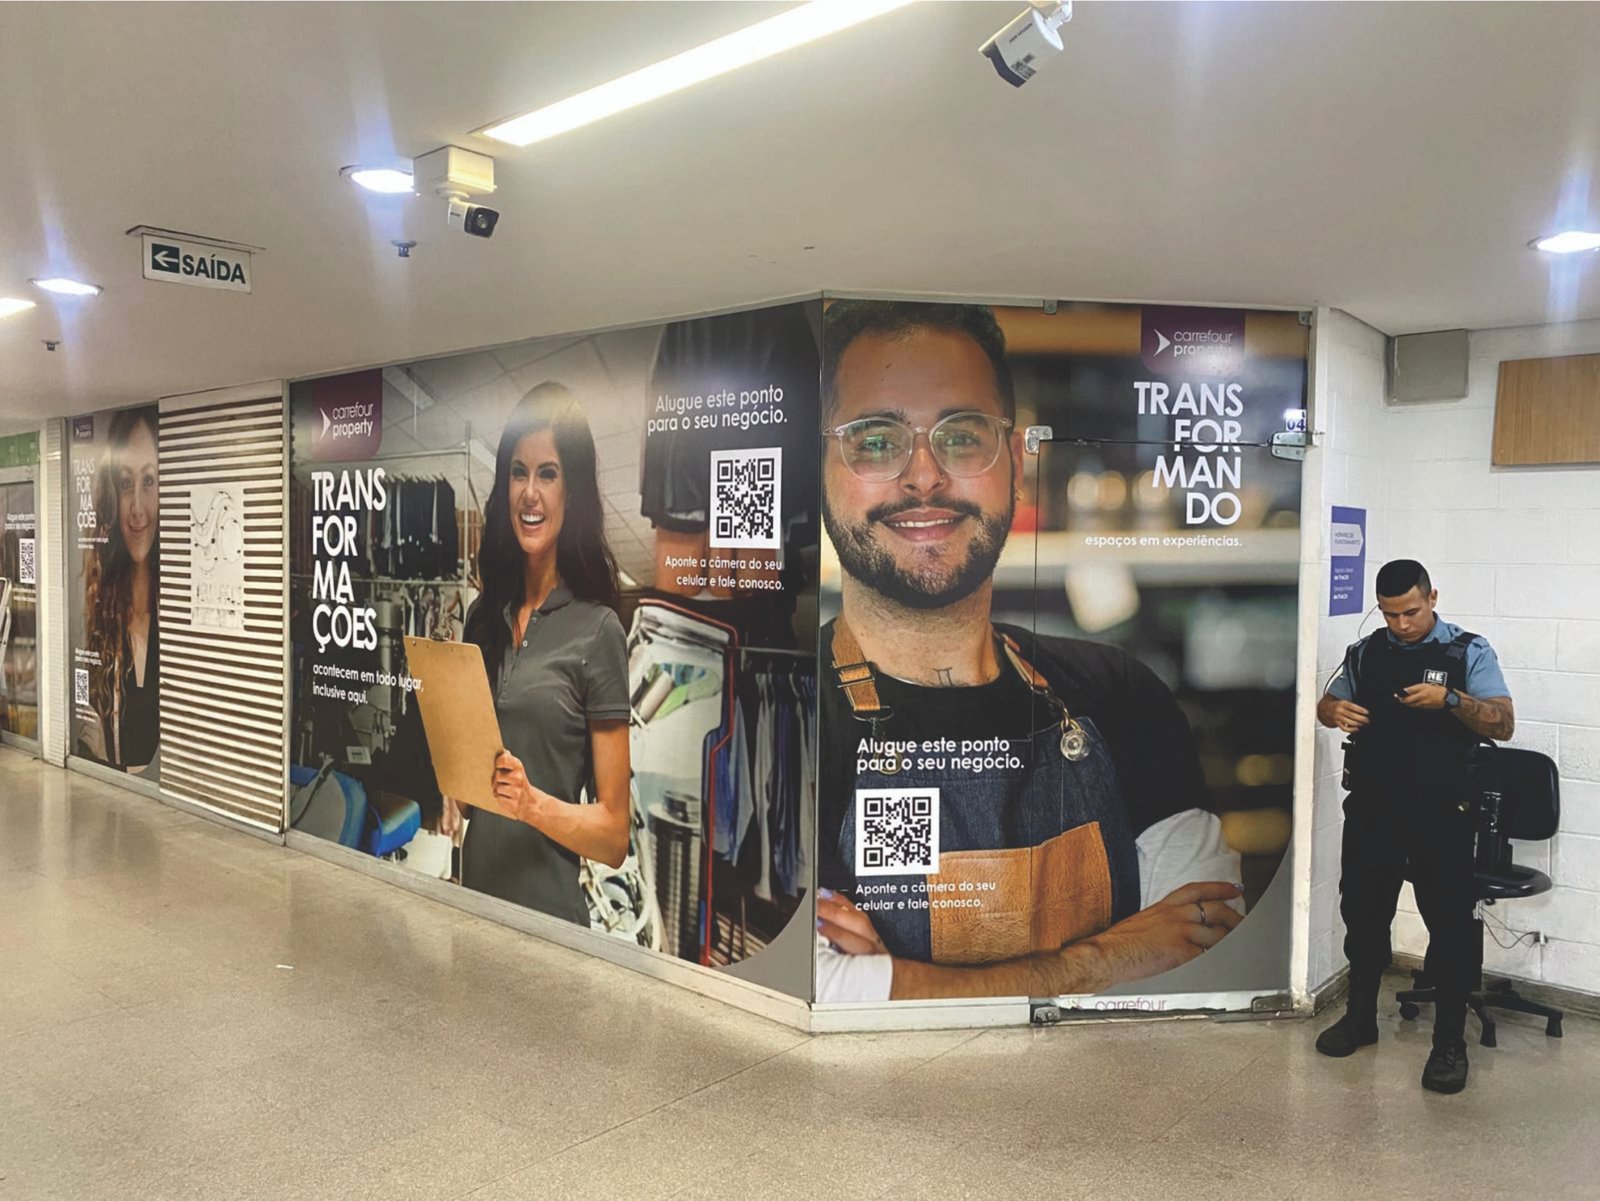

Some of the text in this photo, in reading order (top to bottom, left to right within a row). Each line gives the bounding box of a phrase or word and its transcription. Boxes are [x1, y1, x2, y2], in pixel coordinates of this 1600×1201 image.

[182, 254, 246, 284] SAÍDA
[1173, 329, 1233, 344] carrefour
[332, 401, 374, 420] carrefour
[655, 384, 784, 415] Alugue este ponto
[1133, 381, 1244, 417] TRANS
[332, 418, 374, 440] property
[647, 405, 788, 436] para o seu negócio.
[1173, 418, 1243, 453] FOR
[1152, 455, 1242, 489] MAN
[76, 476, 91, 493] FOR
[311, 467, 387, 511] TRANS
[1186, 491, 1242, 526] DO
[312, 514, 359, 557] FOR
[1085, 533, 1243, 549] espaços em experiências.
[665, 555, 783, 571] Aponte a câmera do seu
[312, 560, 355, 602] MA
[676, 574, 785, 591] celular e fale conosco.
[312, 597, 378, 653] ÇÕES
[313, 663, 424, 693] acontecem em todo lugar,
[312, 681, 369, 705] inclusive aqui.
[856, 736, 1010, 756] Alugue este ponto
[856, 752, 1025, 775] para o seu negócio.
[855, 881, 996, 897] Aponte a câmera do seu
[855, 898, 984, 911] celular e fale conosco.
[1095, 997, 1167, 1012] carrefour
